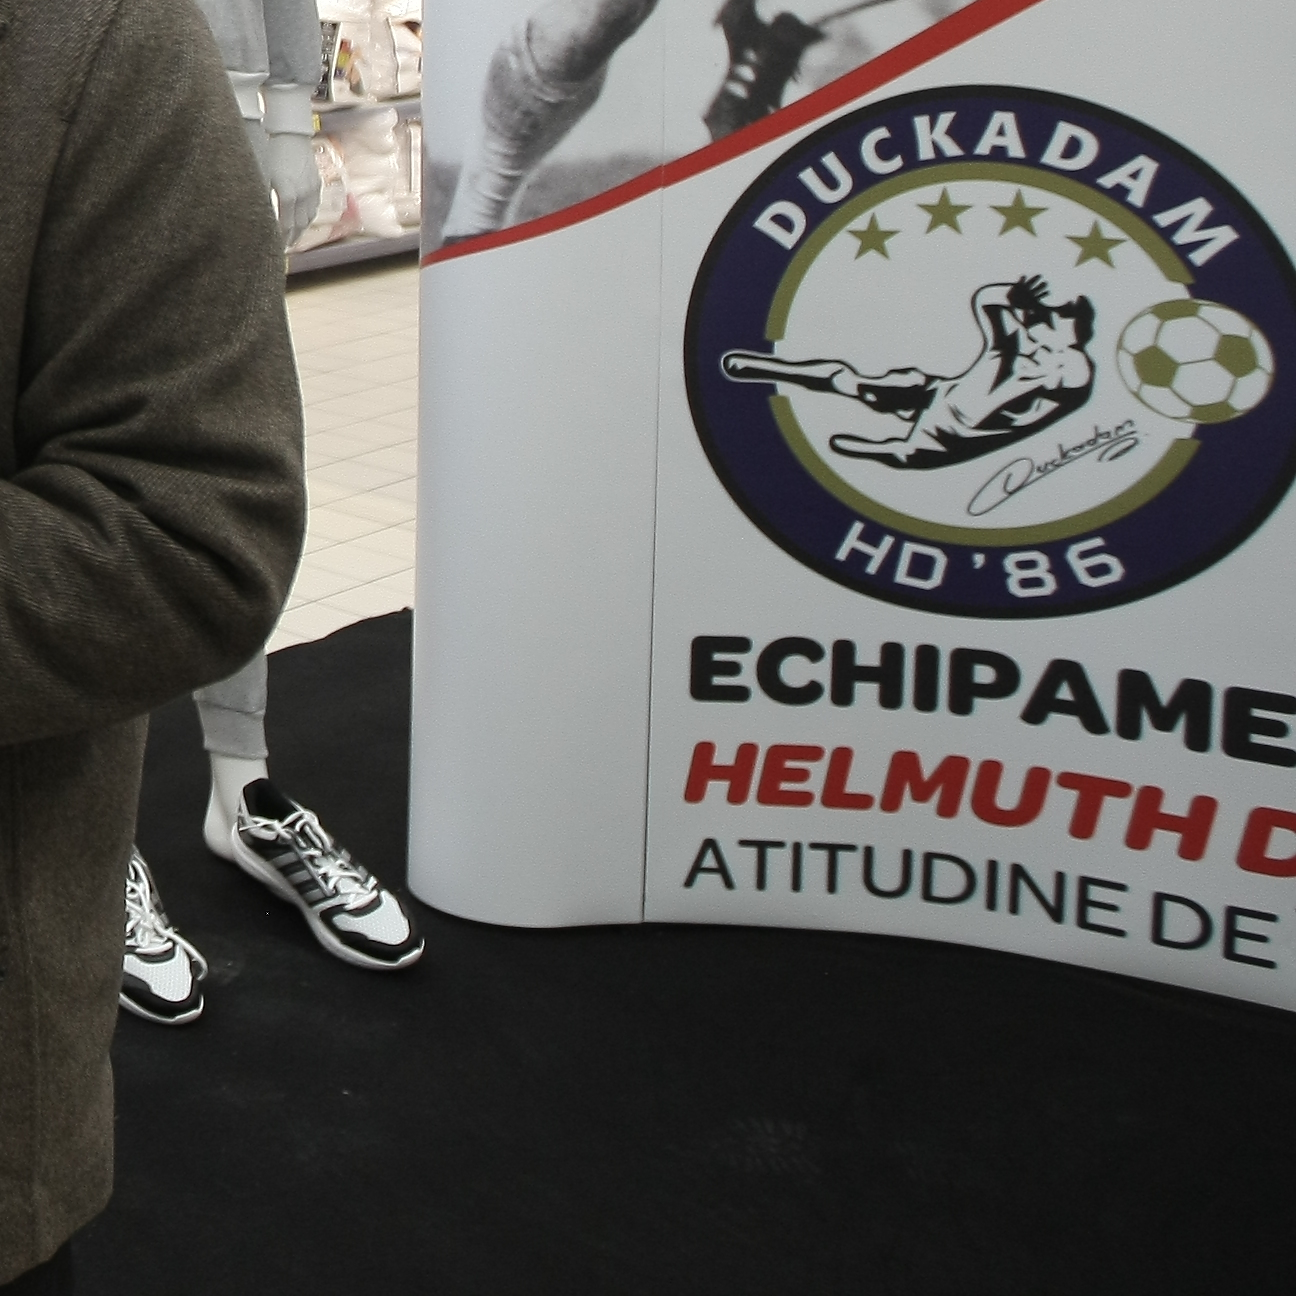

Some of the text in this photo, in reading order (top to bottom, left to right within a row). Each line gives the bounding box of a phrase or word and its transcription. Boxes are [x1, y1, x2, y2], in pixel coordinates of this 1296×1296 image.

[752, 110, 1240, 269] DUCKADAM
[834, 521, 1127, 599] HD '86
[683, 741, 1219, 864] HELMUTH
[683, 838, 1280, 970] ATITUDINE DE
